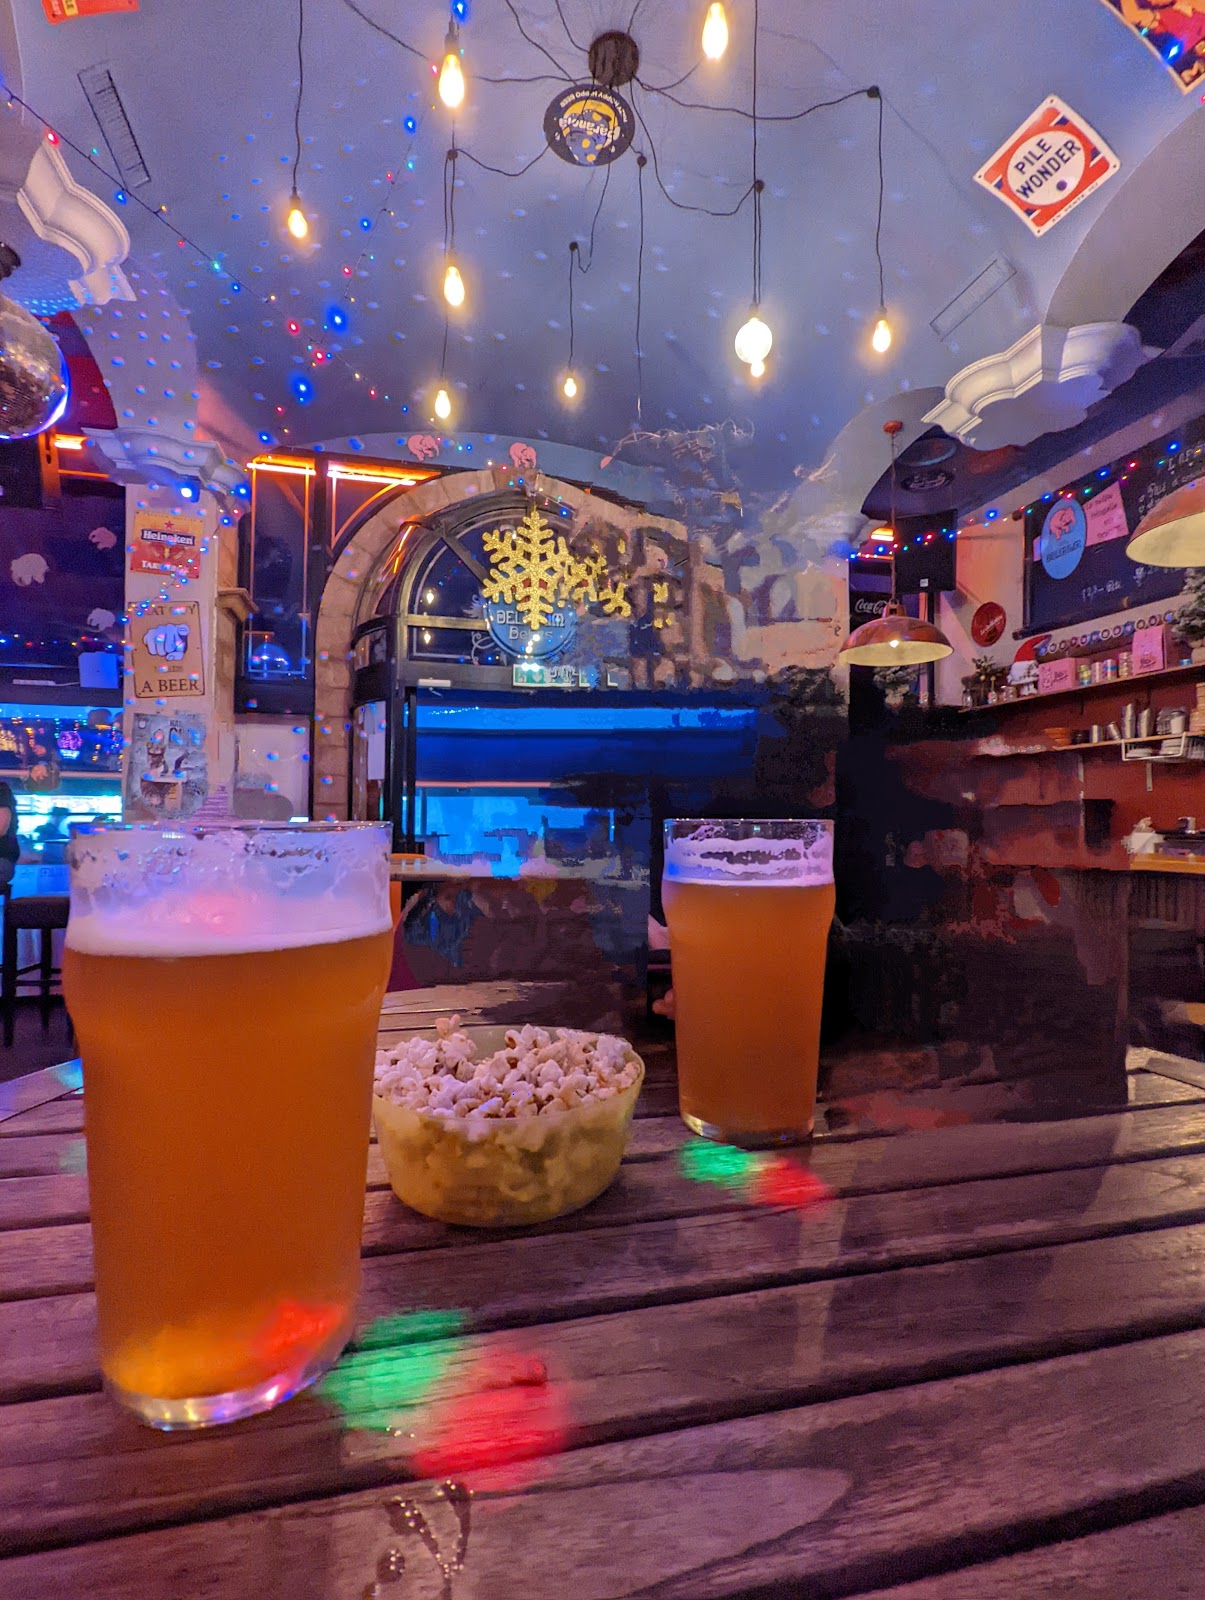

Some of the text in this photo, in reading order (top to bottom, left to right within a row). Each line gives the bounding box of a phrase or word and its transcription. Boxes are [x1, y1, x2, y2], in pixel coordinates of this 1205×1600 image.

[1014, 138, 1052, 175] PILE
[1016, 140, 1081, 199] WONDER
[143, 530, 194, 545] Heineken
[141, 678, 199, 693] A BEER
